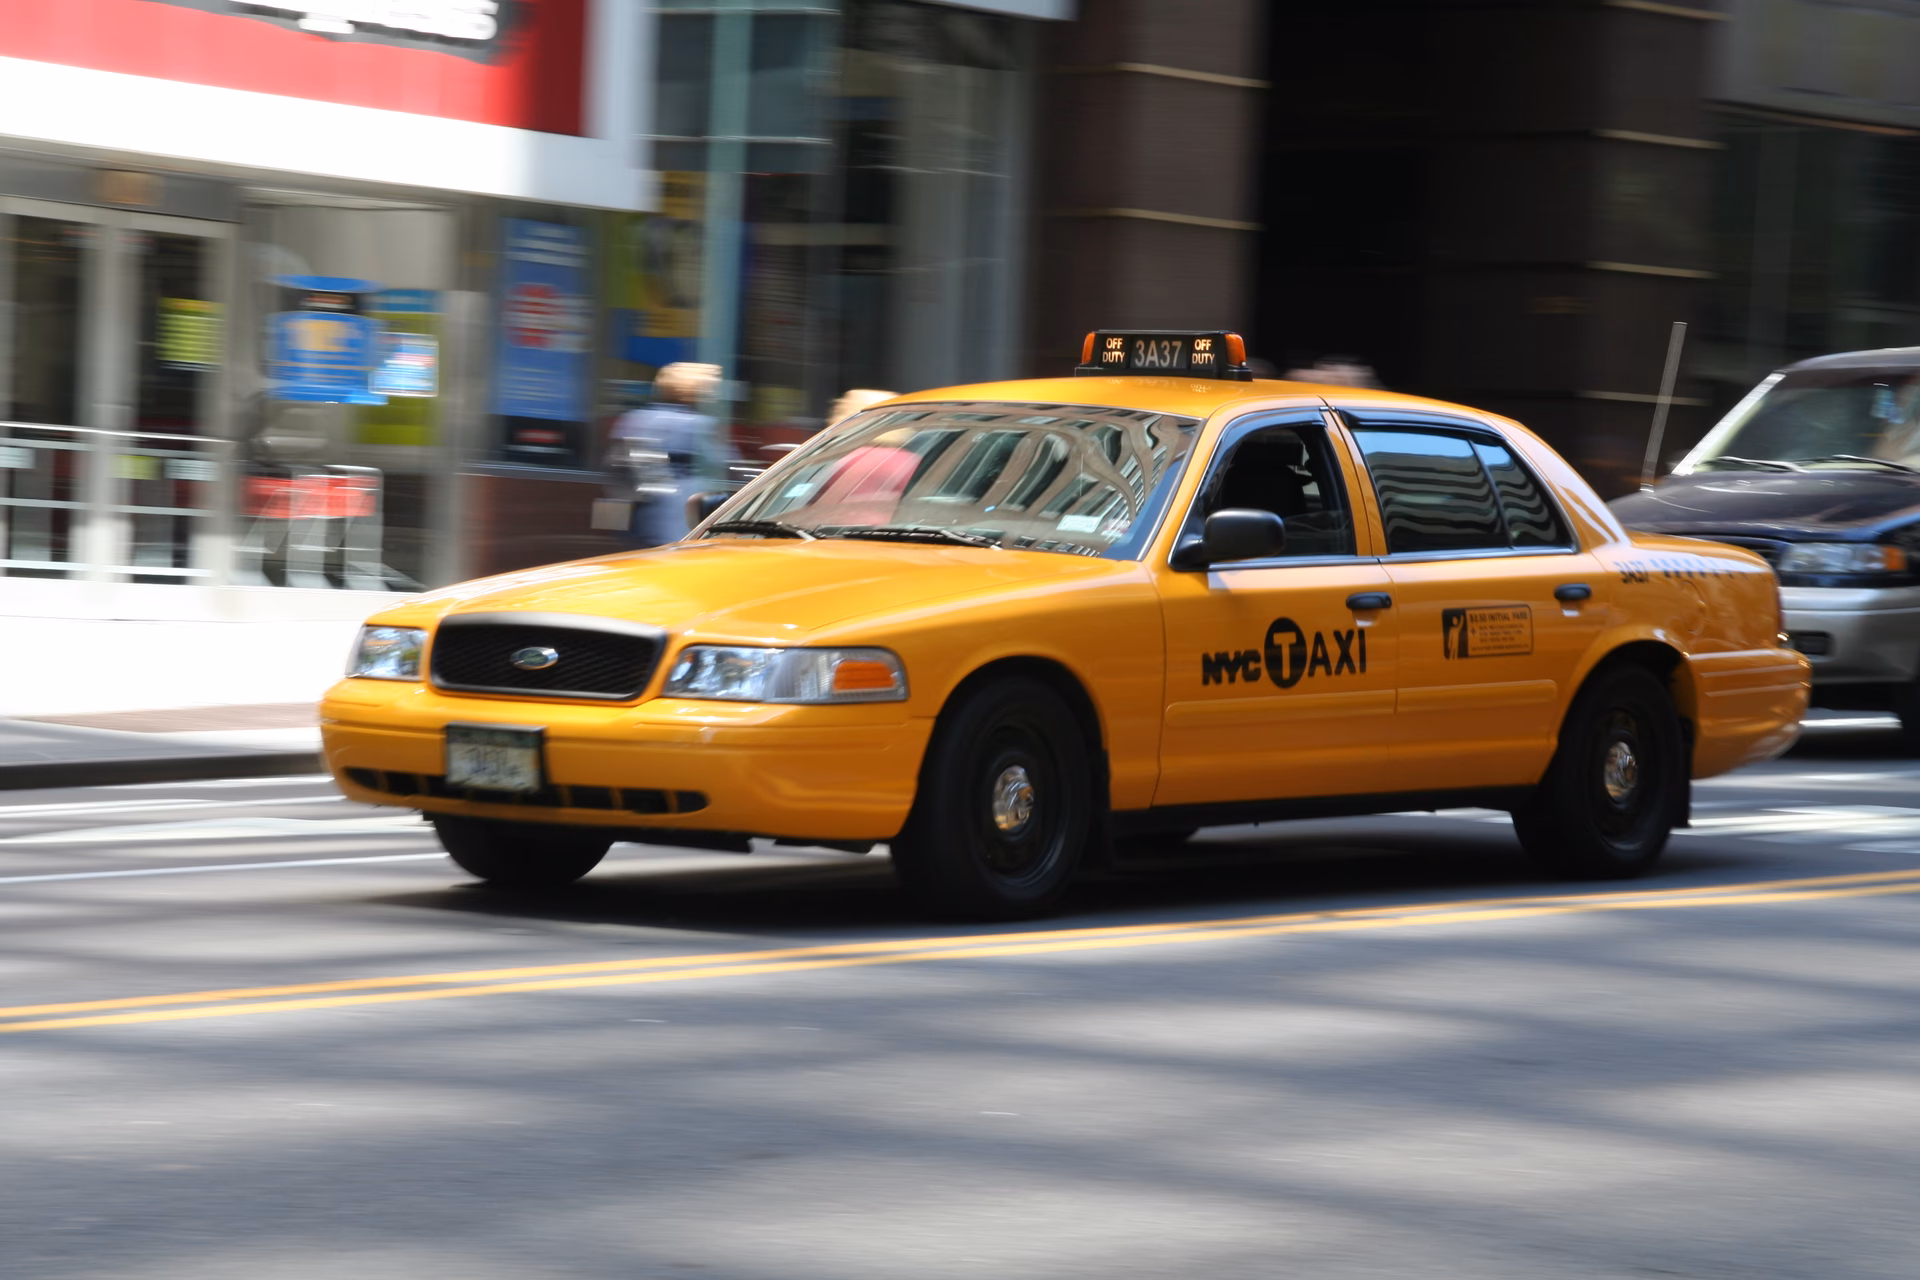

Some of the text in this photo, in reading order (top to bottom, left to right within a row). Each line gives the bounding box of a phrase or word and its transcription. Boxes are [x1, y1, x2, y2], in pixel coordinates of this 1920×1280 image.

[1106, 337, 1123, 349] OFF
[1194, 339, 1212, 351] OFF
[1102, 351, 1125, 363] DUTY
[1134, 340, 1182, 367] 3A37
[1192, 353, 1215, 365] DUTY
[1202, 619, 1366, 687] NYC TAXI
